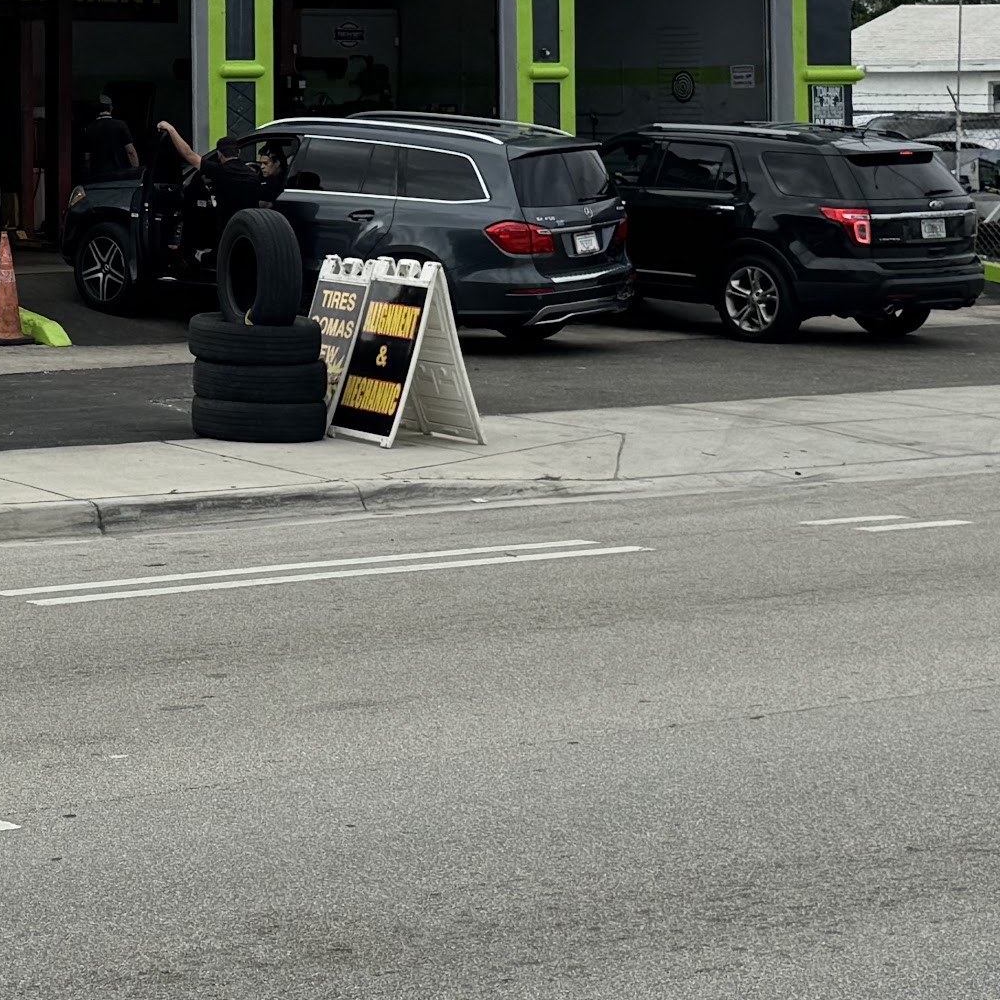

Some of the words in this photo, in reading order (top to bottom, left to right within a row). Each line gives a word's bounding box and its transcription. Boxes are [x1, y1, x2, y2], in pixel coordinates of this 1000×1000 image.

[321, 289, 357, 312] TIRES
[362, 300, 421, 340] ALIGNMENT
[319, 344, 340, 364] EW
[375, 345, 388, 366] &
